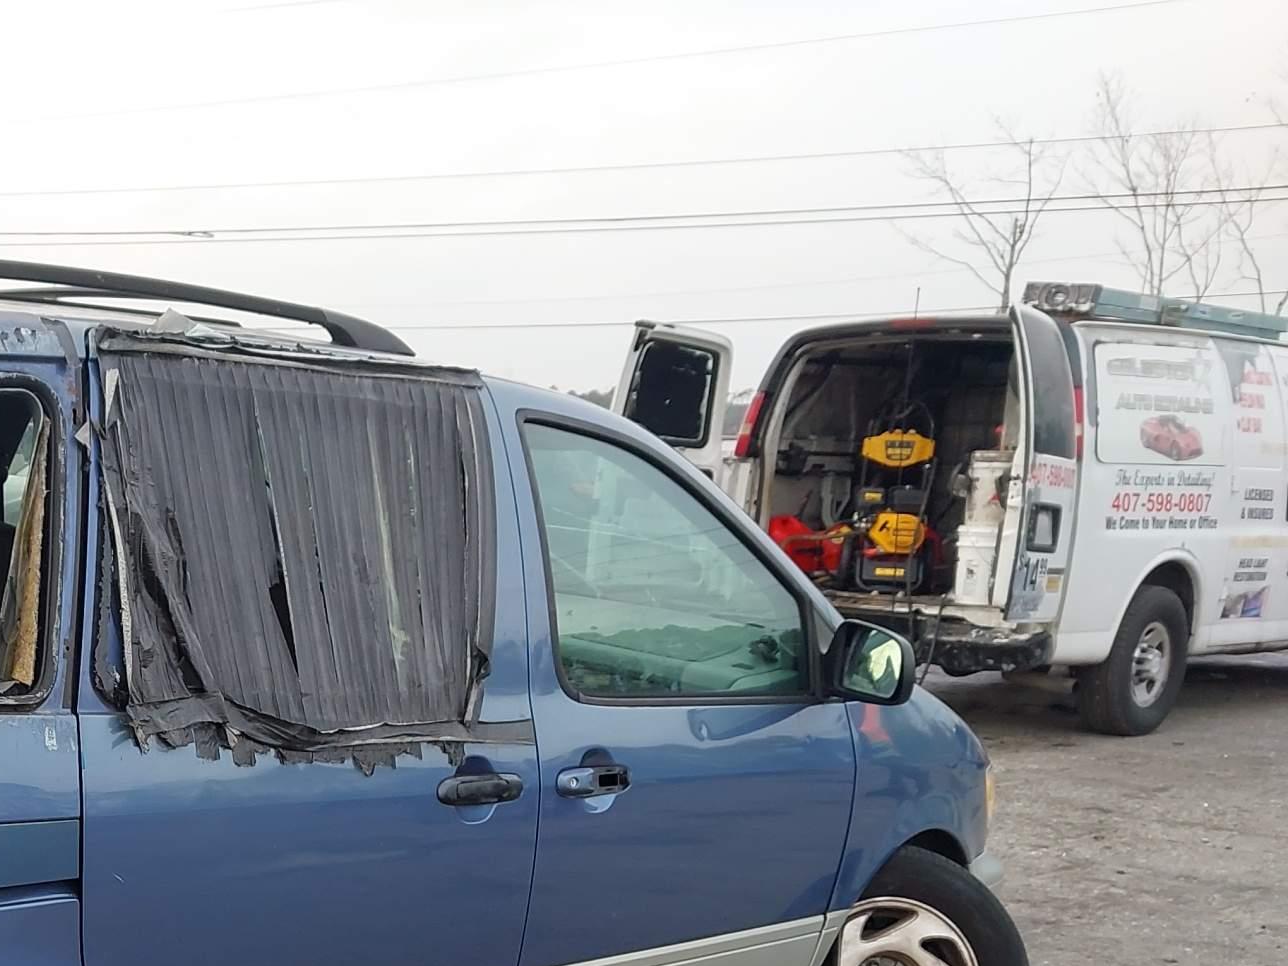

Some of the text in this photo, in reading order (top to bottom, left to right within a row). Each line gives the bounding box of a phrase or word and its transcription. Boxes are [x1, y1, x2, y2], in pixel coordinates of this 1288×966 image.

[1115, 468, 1132, 486] The
[1134, 469, 1166, 490] Experts
[1167, 472, 1175, 486] in
[1112, 492, 1212, 512] 407-598-0807
[1241, 507, 1246, 519] &
[1105, 515, 1218, 530] We Come to Your Home or Office
